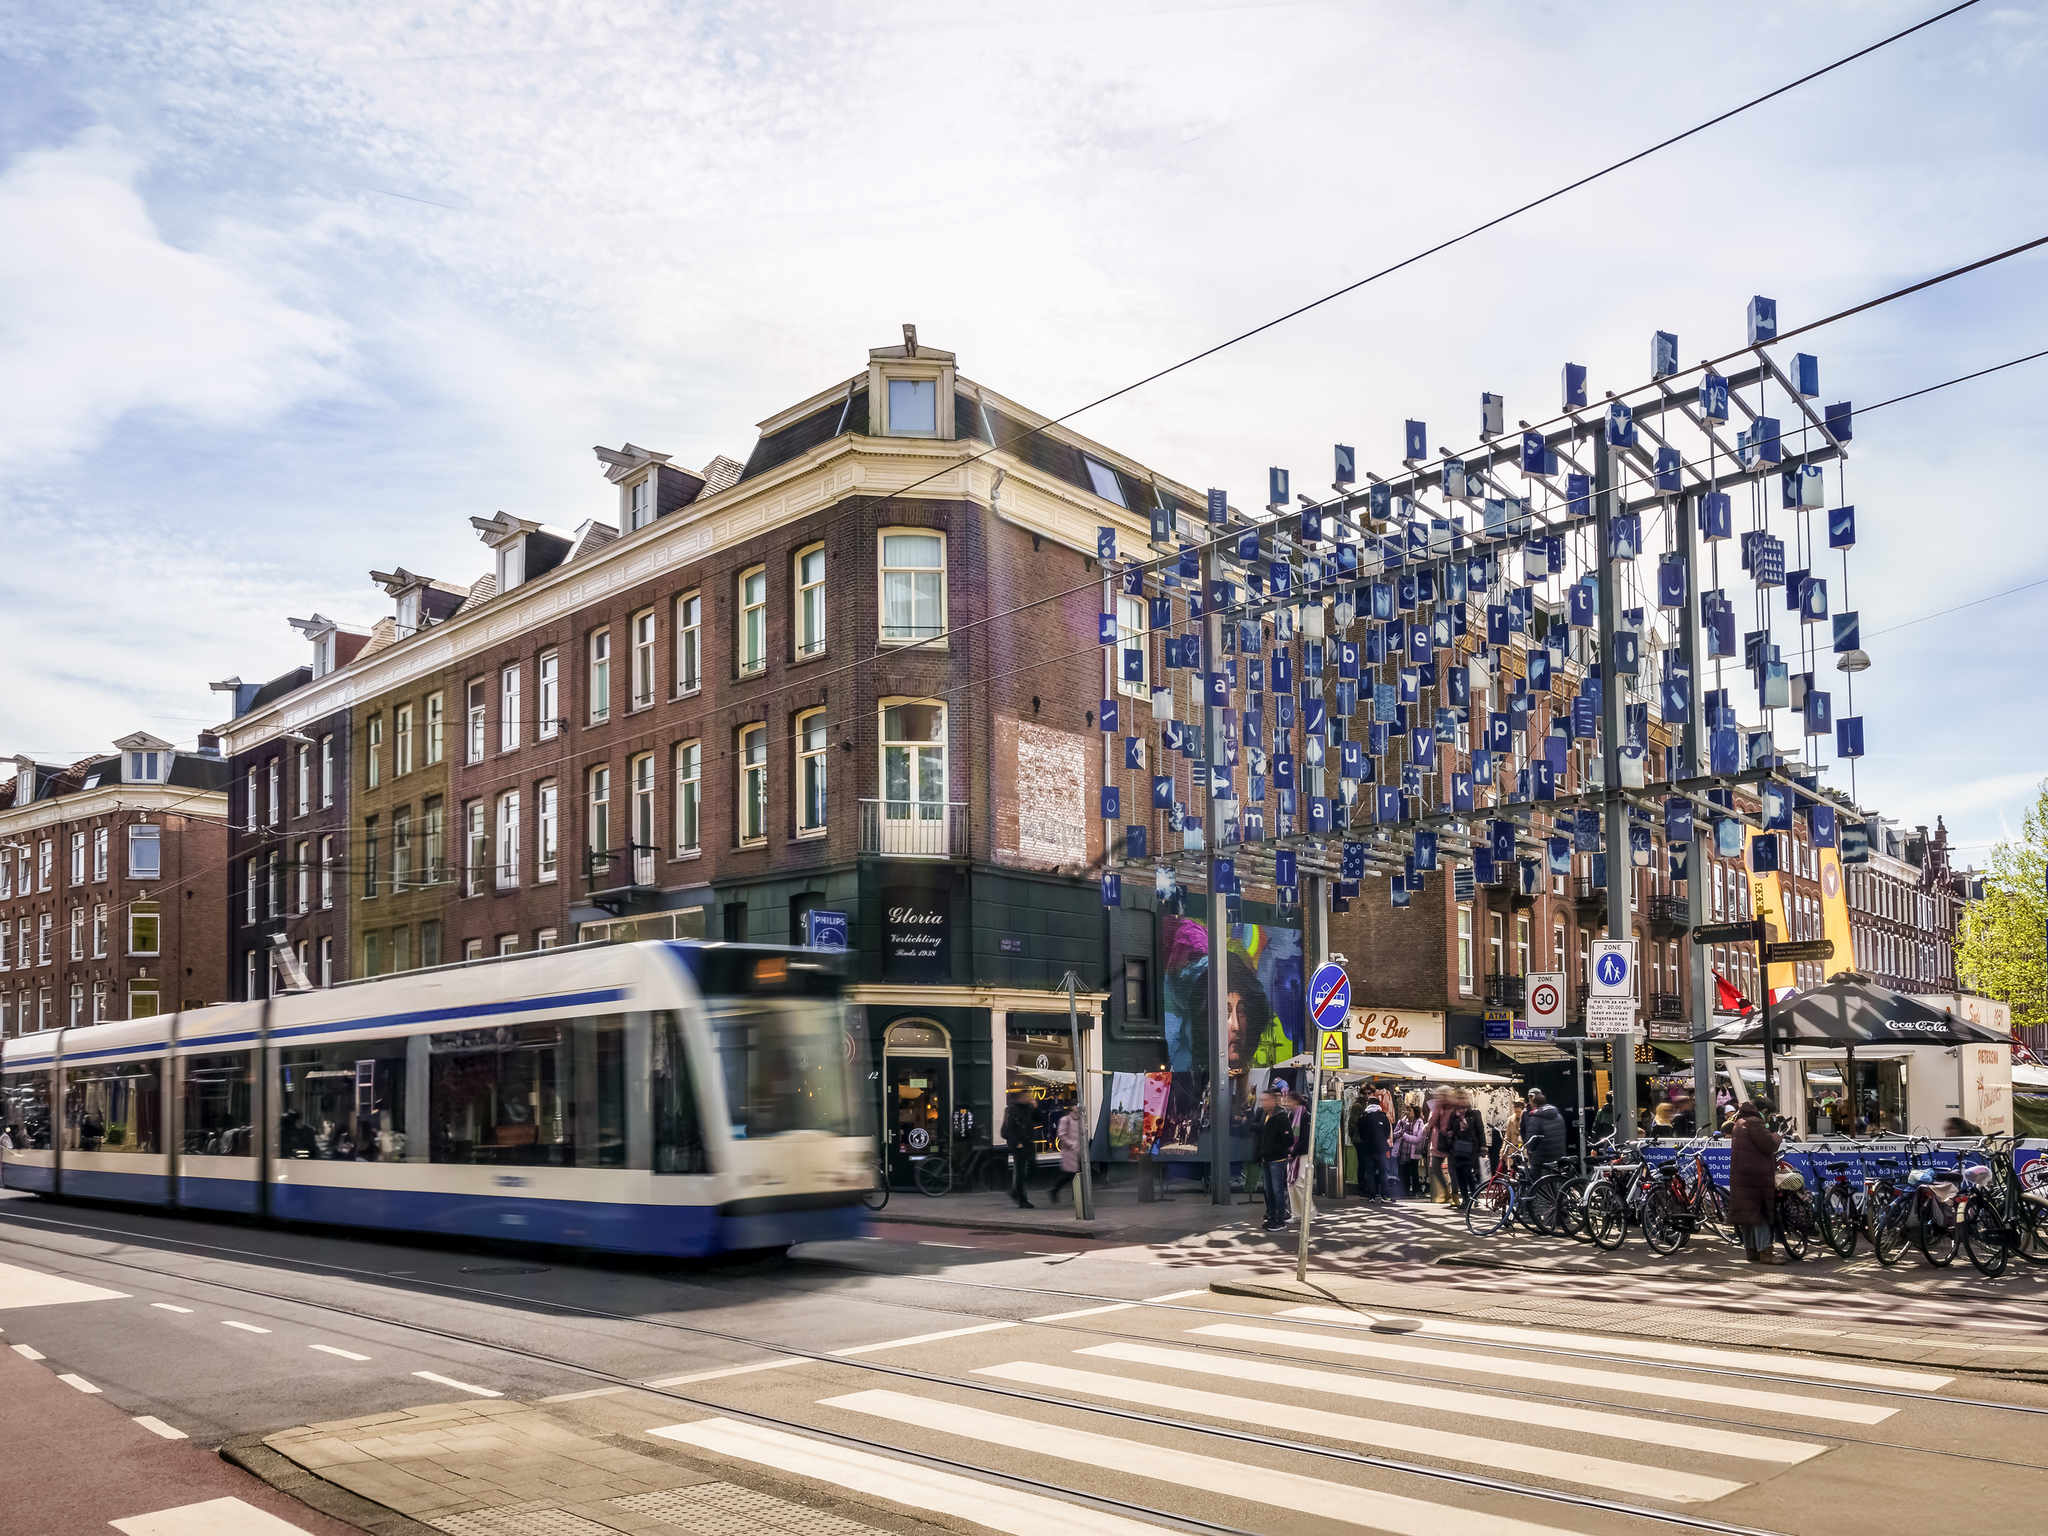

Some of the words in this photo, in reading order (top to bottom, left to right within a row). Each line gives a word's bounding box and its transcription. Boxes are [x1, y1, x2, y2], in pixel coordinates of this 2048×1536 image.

[1214, 679, 1226, 693] a
[1342, 645, 1355, 664] b
[1414, 631, 1428, 647] e
[1494, 612, 1503, 629] r
[1577, 589, 1588, 610] t
[1278, 760, 1289, 775] c
[1345, 748, 1358, 763] u
[1416, 735, 1430, 756] y
[1494, 720, 1508, 741] p
[1244, 812, 1263, 828] m
[1312, 803, 1325, 818] a
[1384, 792, 1392, 808] r
[1456, 776, 1469, 797] k
[1539, 764, 1548, 784] t
[815, 915, 846, 926] PHILIPS
[888, 906, 943, 925] Gloria
[889, 933, 942, 948] Verlichting
[1537, 993, 1554, 1006] 30
[1488, 1011, 1507, 1020] ATM
[1355, 1012, 1379, 1043] La
[868, 1071, 879, 1080] 12
